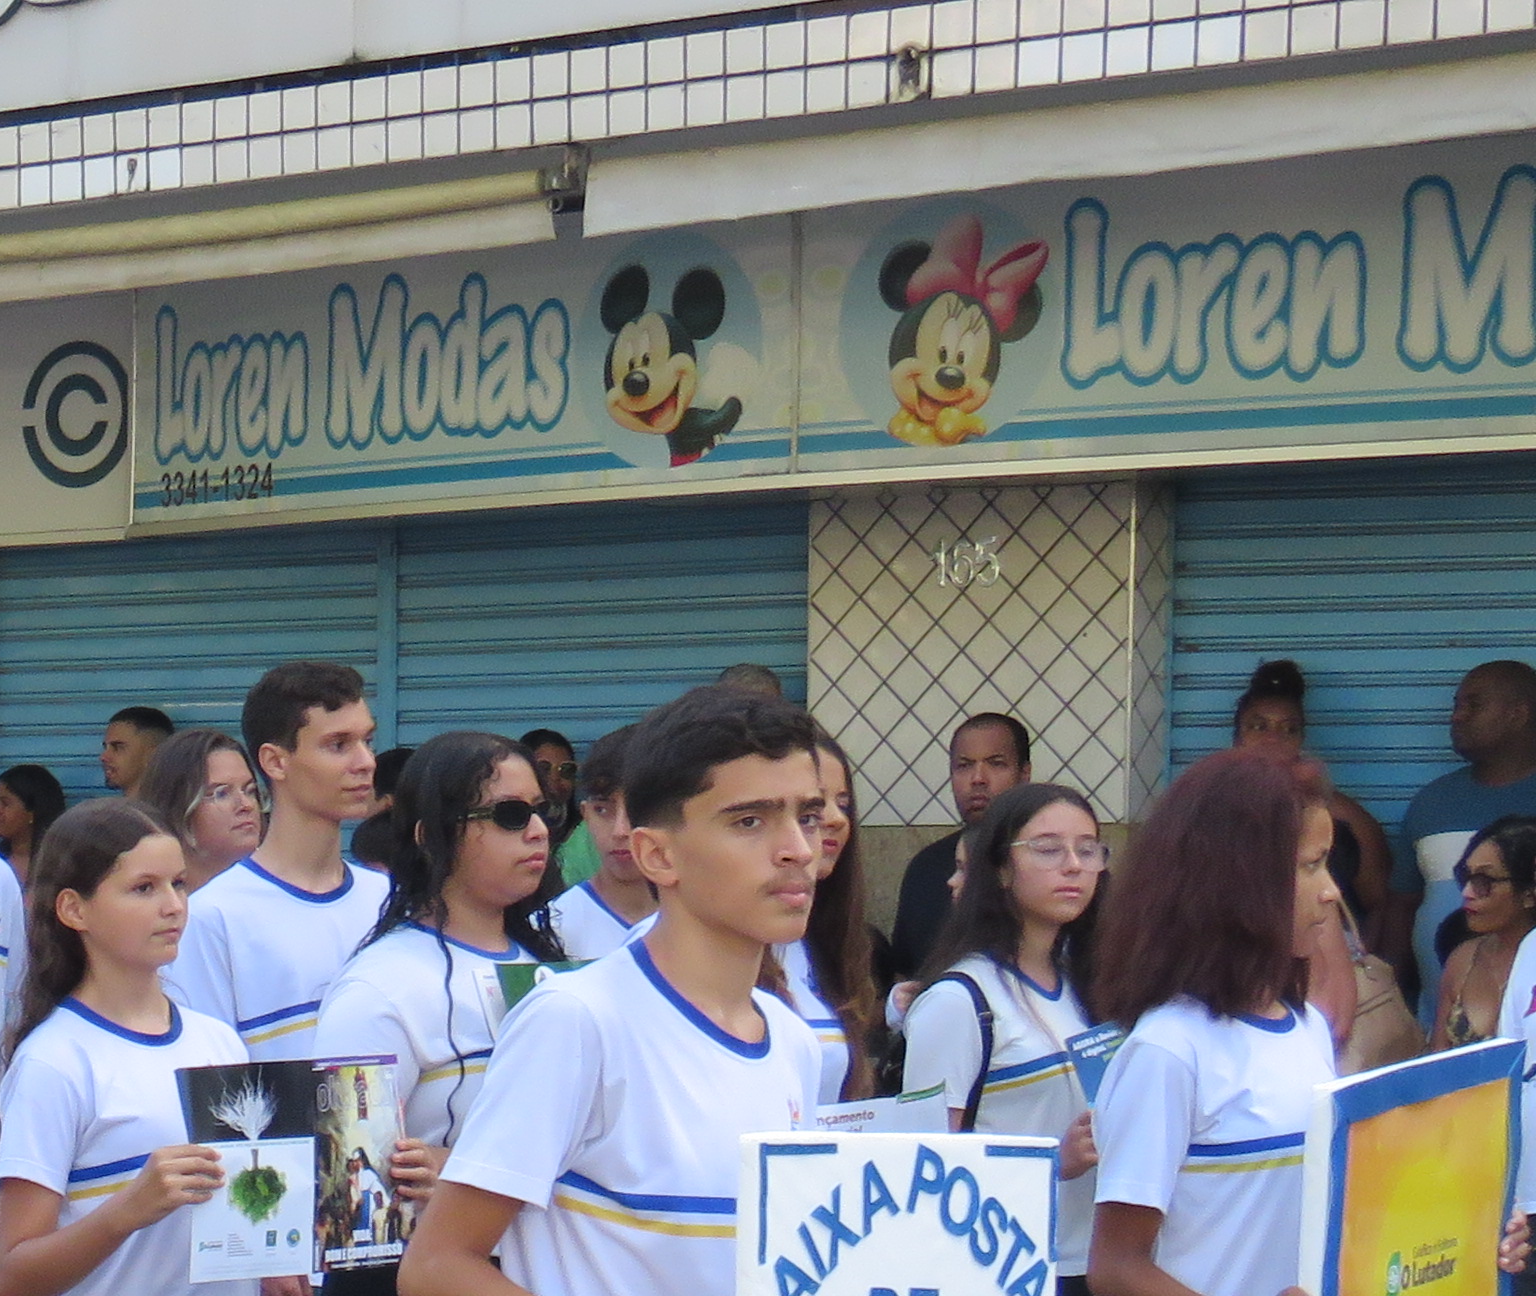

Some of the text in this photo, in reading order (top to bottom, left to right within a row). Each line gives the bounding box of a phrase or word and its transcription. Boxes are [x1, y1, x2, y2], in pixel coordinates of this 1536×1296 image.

[1060, 197, 1368, 390] Loren
[154, 272, 571, 466] Loren Modas
[160, 462, 274, 508] 3341-1324
[931, 535, 1001, 588] 165
[816, 1110, 874, 1126] nçamento
